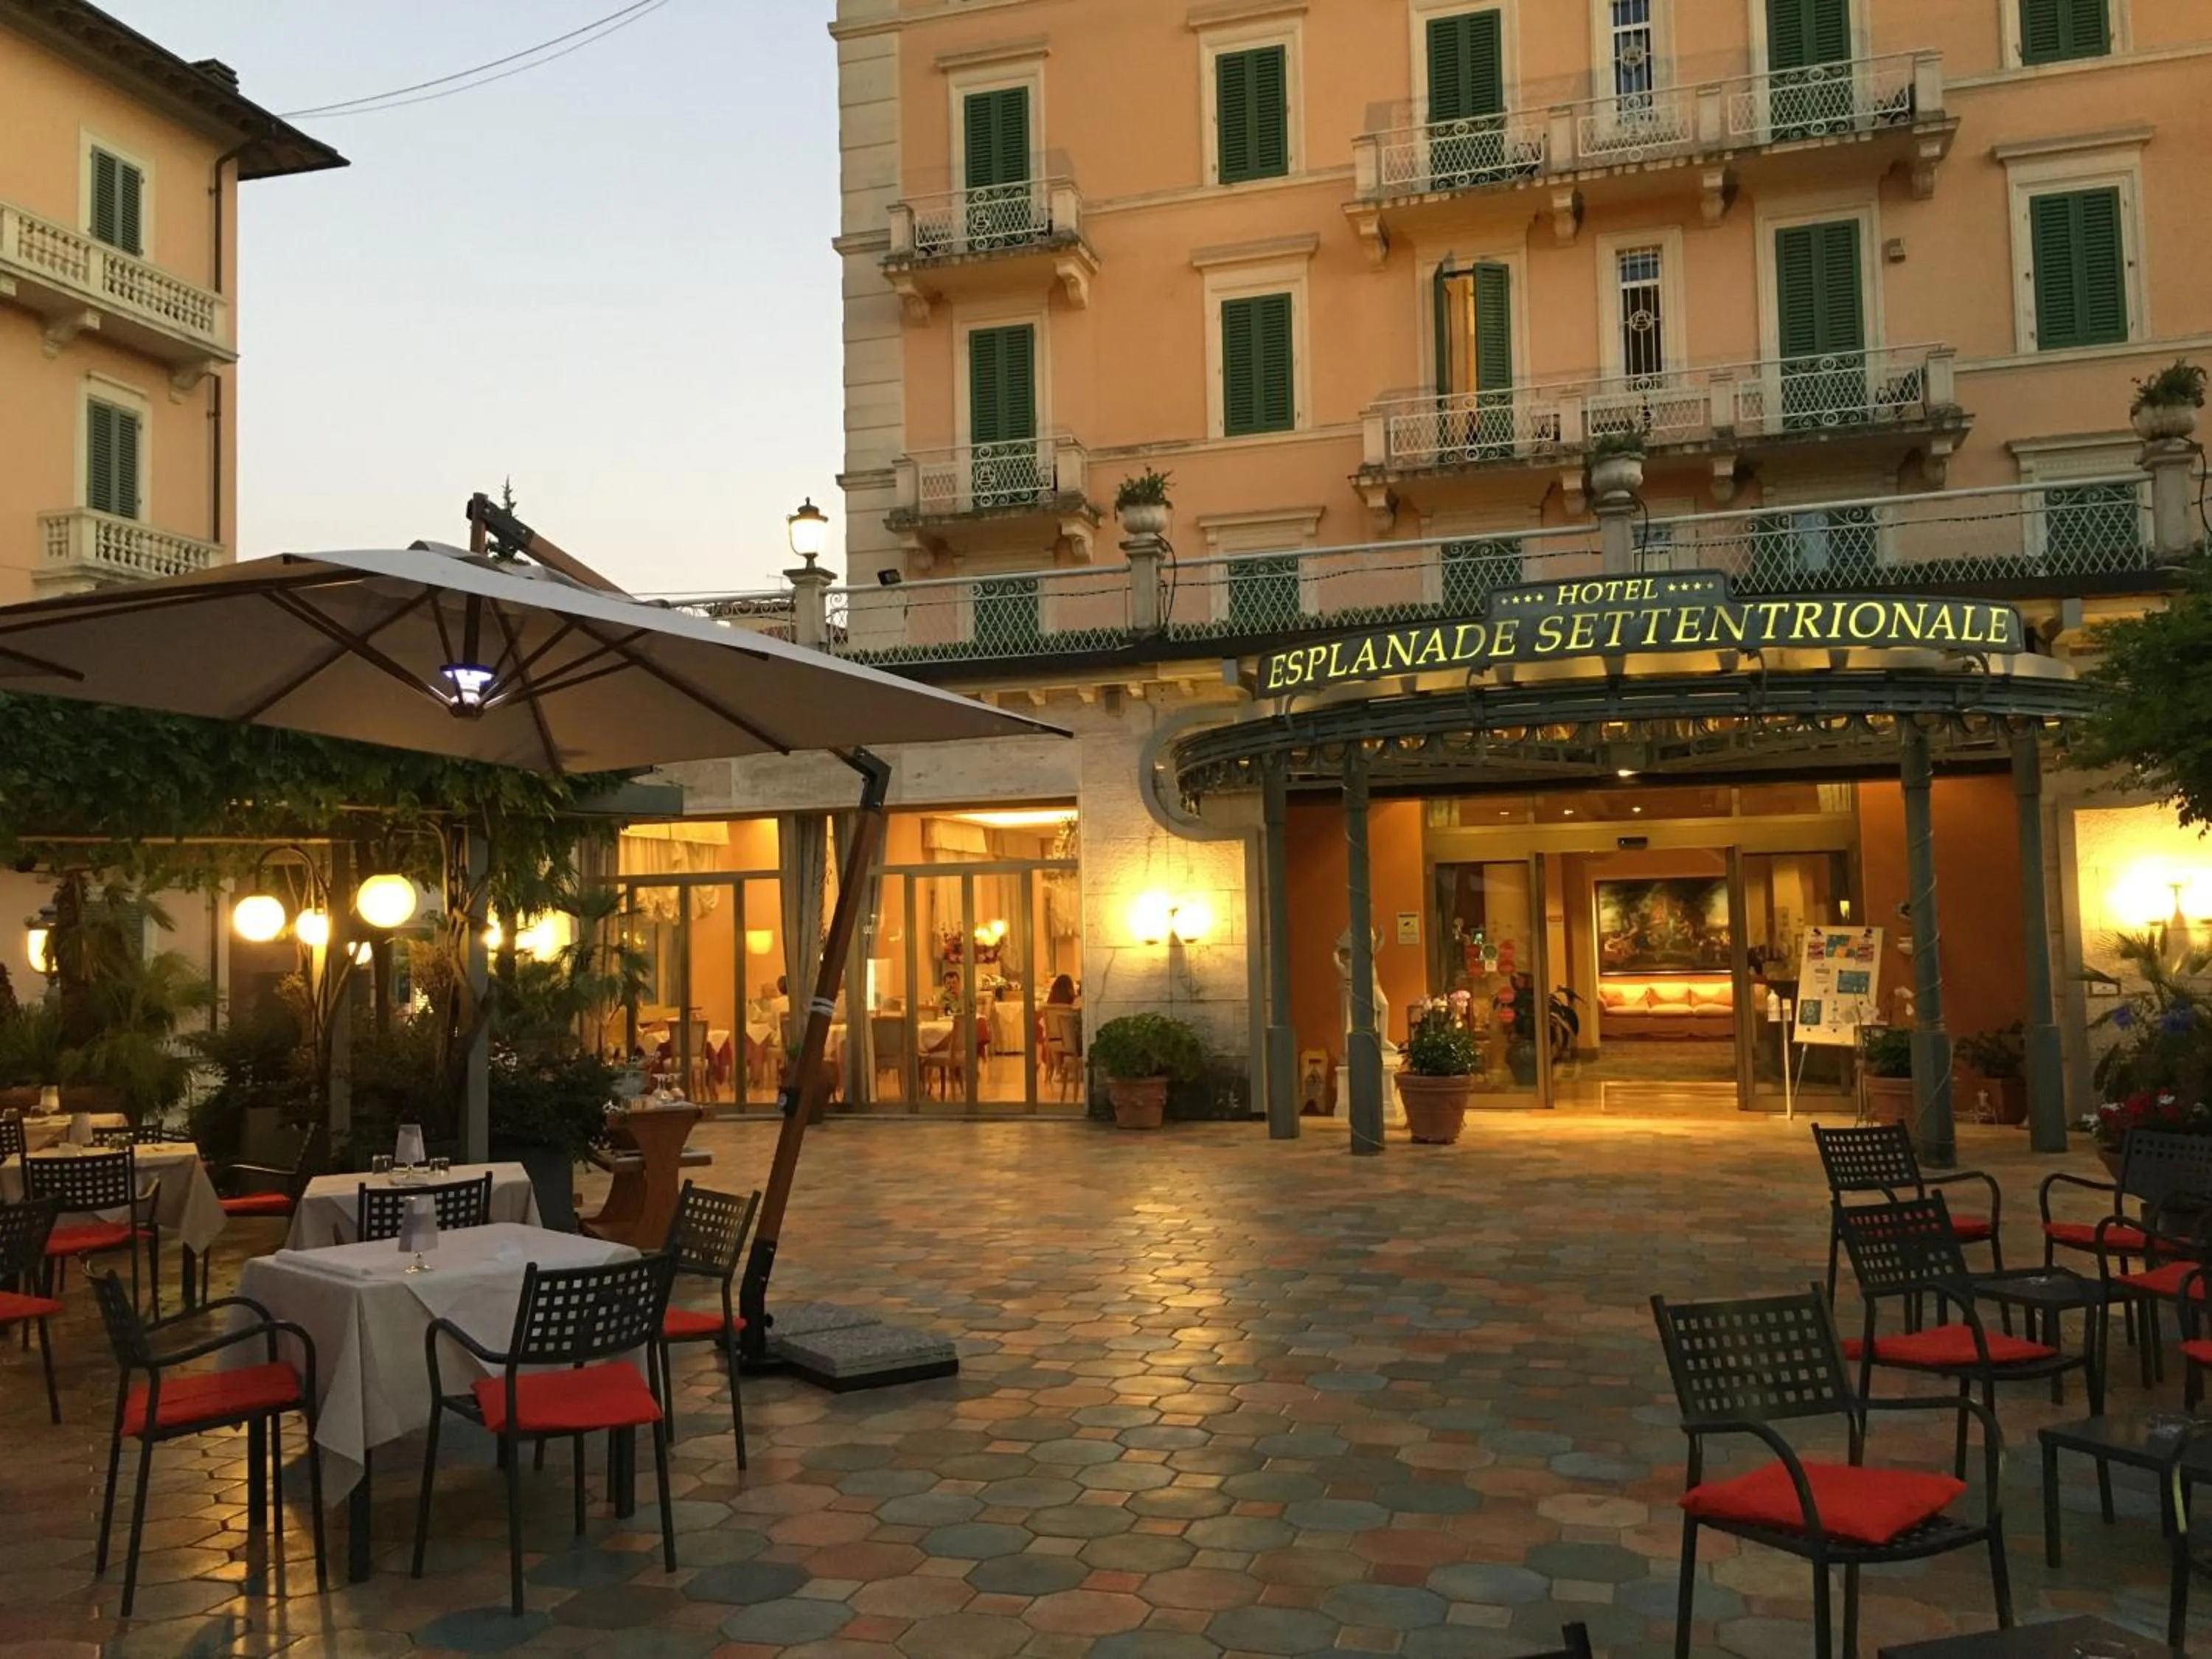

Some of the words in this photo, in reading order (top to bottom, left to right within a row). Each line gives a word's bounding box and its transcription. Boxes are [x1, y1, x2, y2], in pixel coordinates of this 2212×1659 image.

[1556, 579, 1658, 606] HOTEL
[1267, 619, 1520, 689] ESPLANADE
[1534, 601, 2010, 653] SETTENTRIONALE
